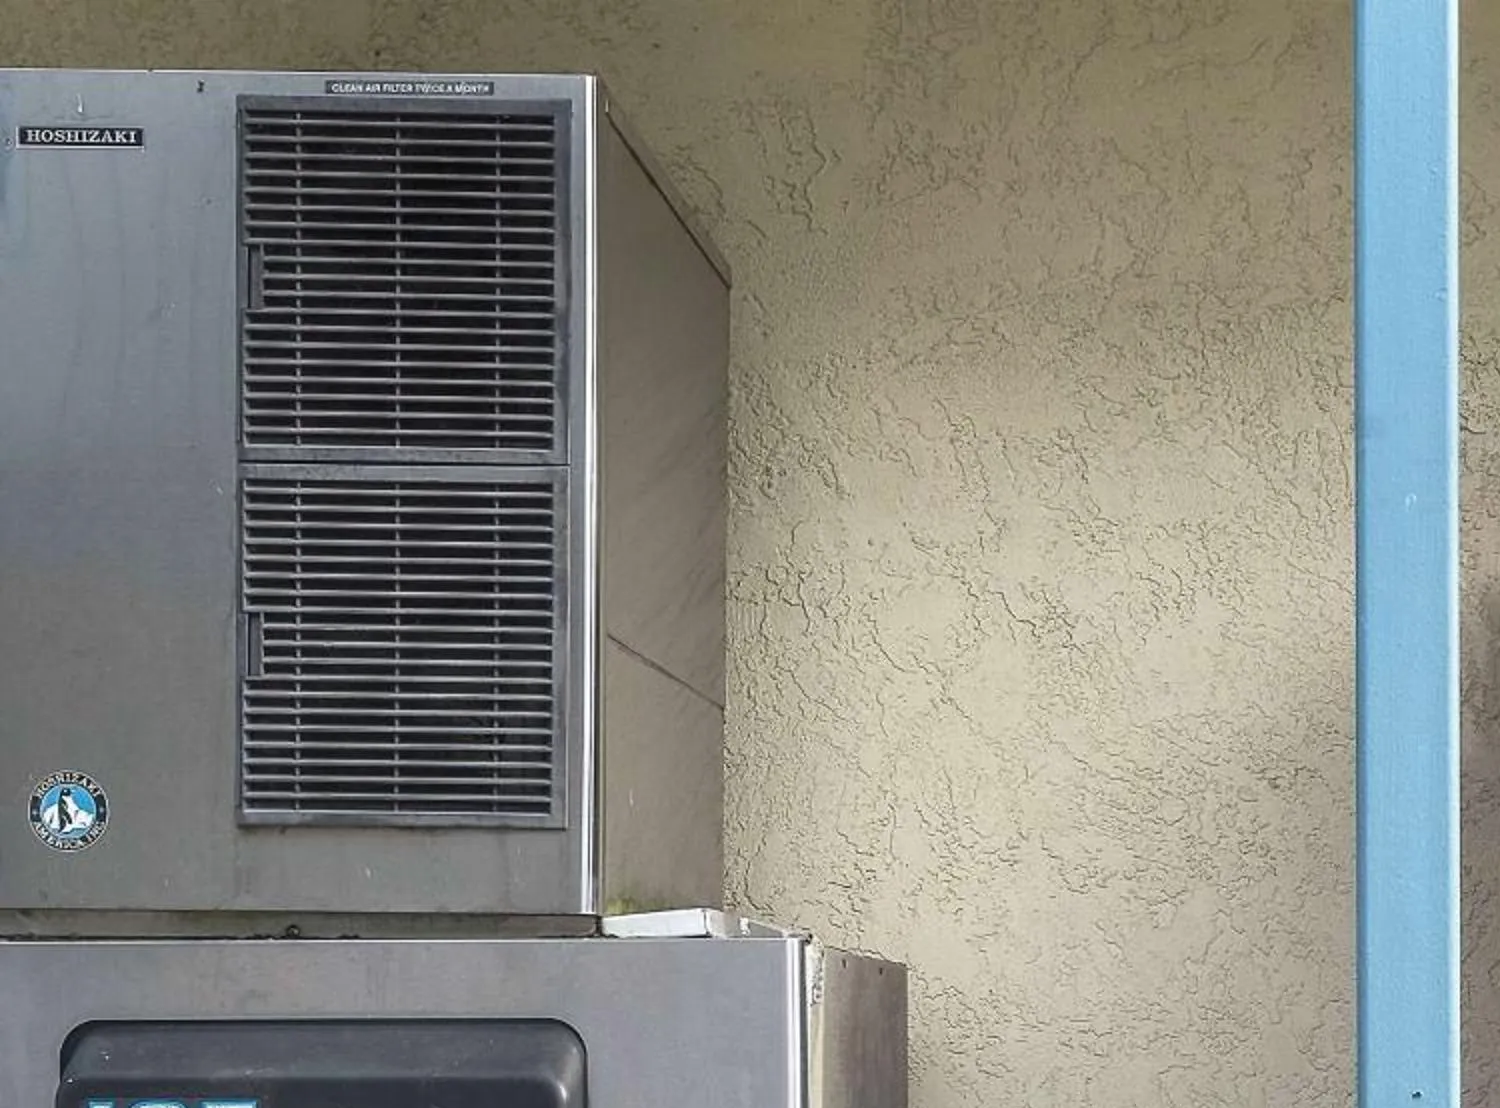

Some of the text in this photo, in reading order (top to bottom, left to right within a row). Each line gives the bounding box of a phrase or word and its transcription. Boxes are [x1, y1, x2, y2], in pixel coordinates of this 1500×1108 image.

[331, 83, 363, 93] CLEAN
[366, 83, 381, 93] AIR
[383, 83, 414, 93] FILTER
[415, 83, 445, 93] TWICE
[454, 83, 489, 93] MONTH
[25, 128, 138, 143] HOSHIZAKI
